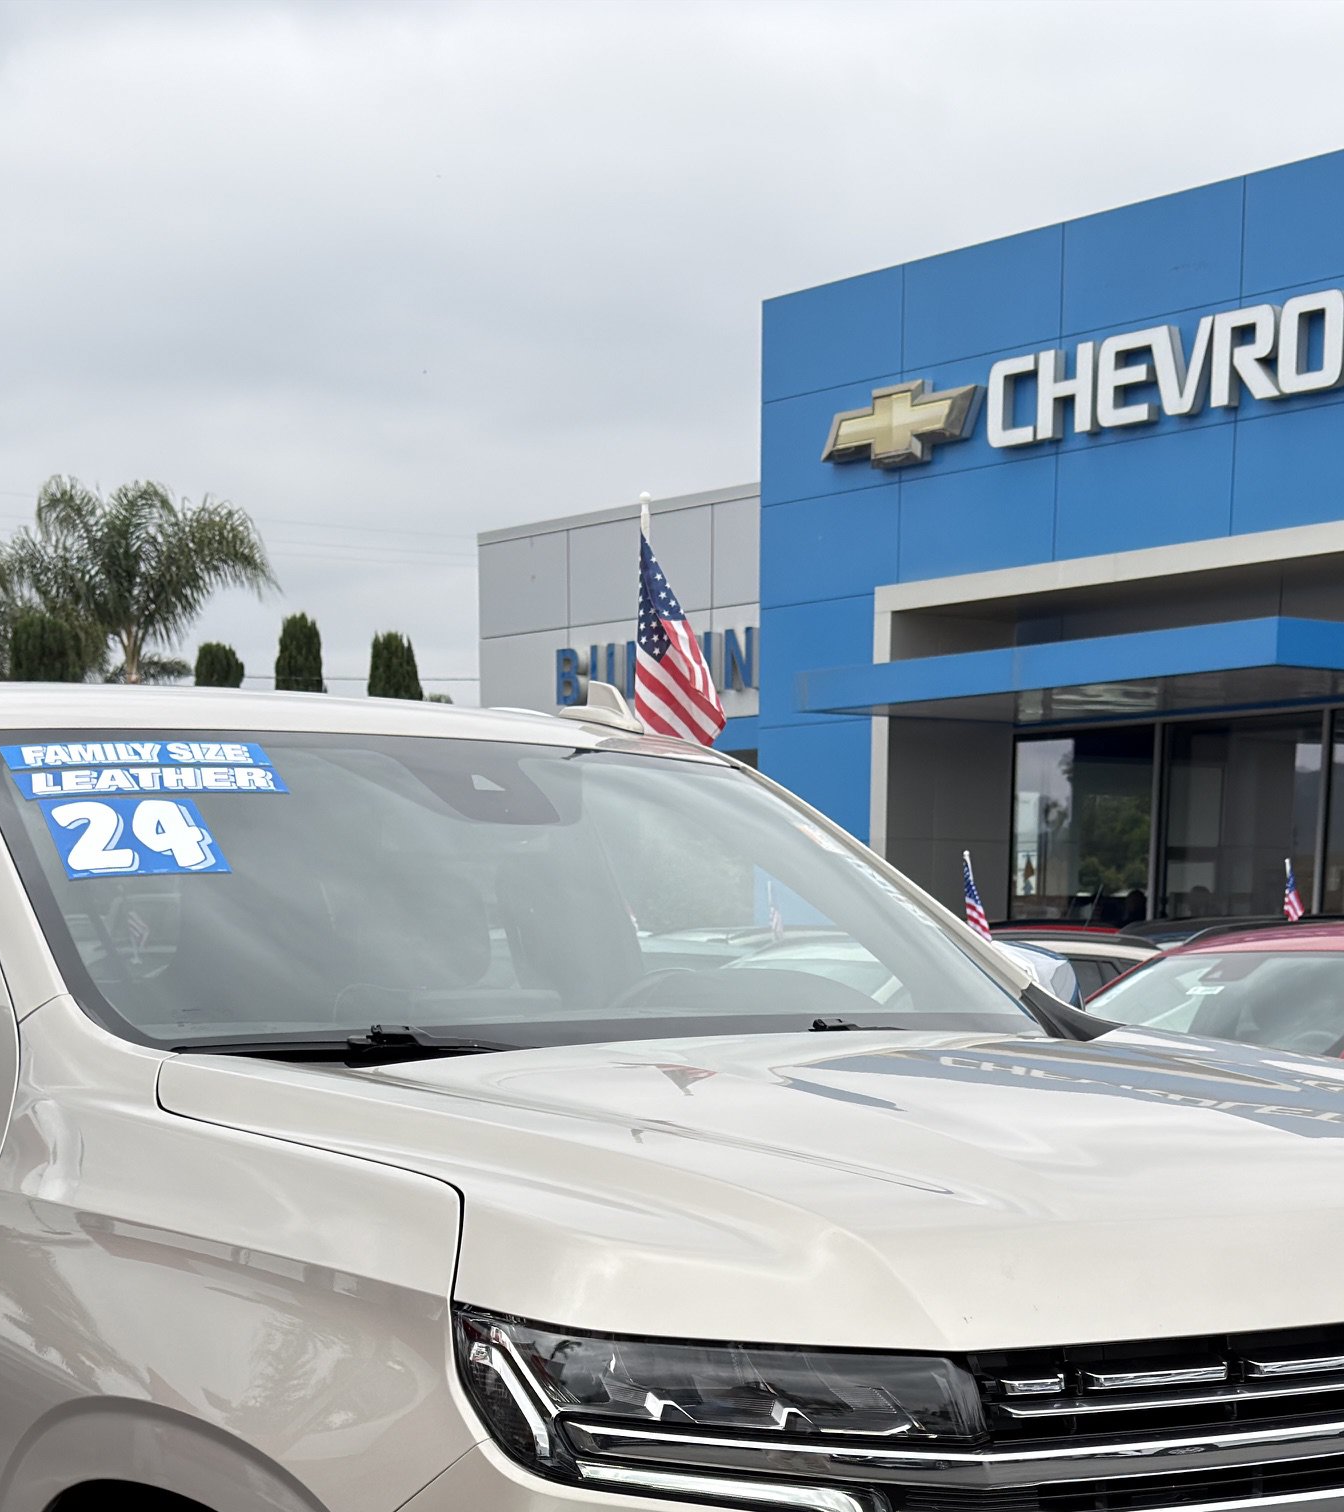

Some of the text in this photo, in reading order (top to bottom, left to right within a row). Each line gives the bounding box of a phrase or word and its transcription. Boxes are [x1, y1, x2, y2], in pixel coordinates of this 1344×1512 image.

[556, 626, 759, 706] BUIN
[20, 742, 253, 766] FAMILY SIZE
[31, 767, 275, 795] LEATHER
[50, 799, 216, 873] 24
